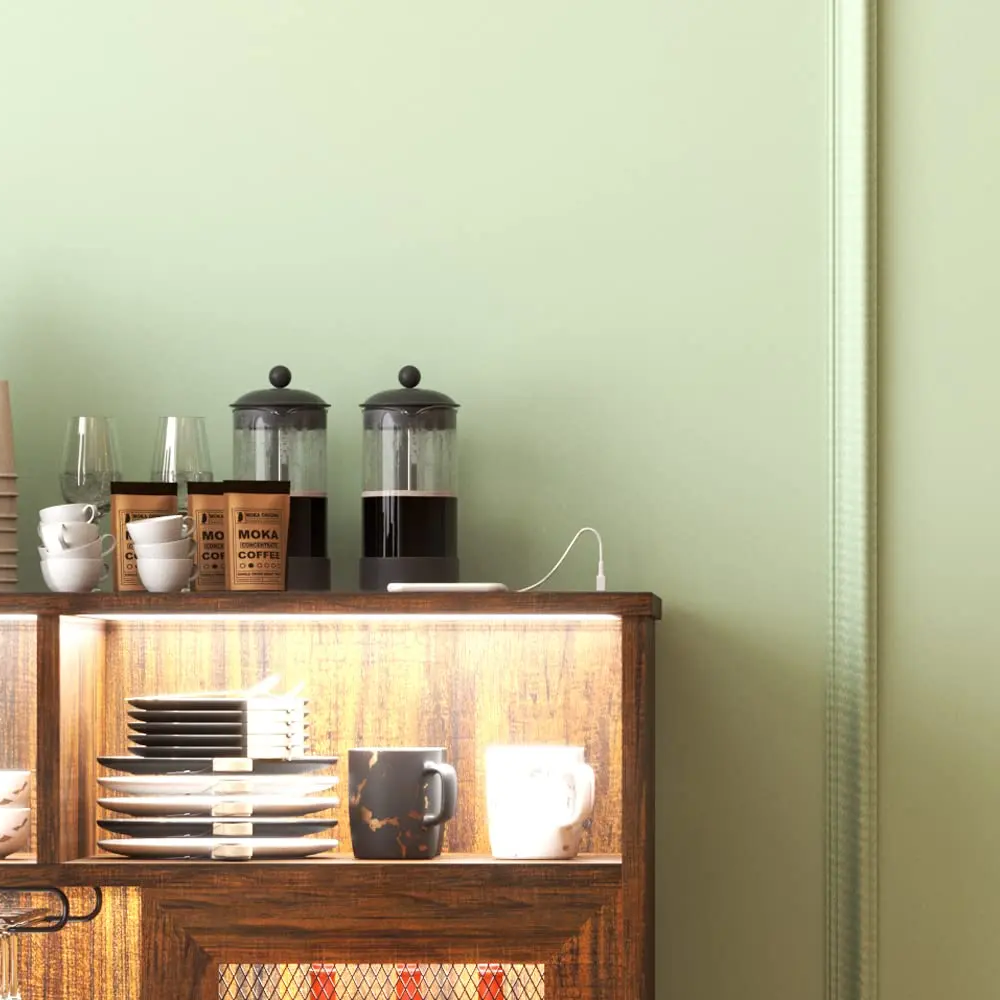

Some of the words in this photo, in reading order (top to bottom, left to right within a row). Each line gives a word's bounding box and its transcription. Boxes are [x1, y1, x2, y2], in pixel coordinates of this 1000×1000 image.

[202, 531, 224, 540] MO
[238, 529, 279, 540] MOKA
[202, 552, 224, 560] COF
[238, 551, 281, 560] COFFEE
